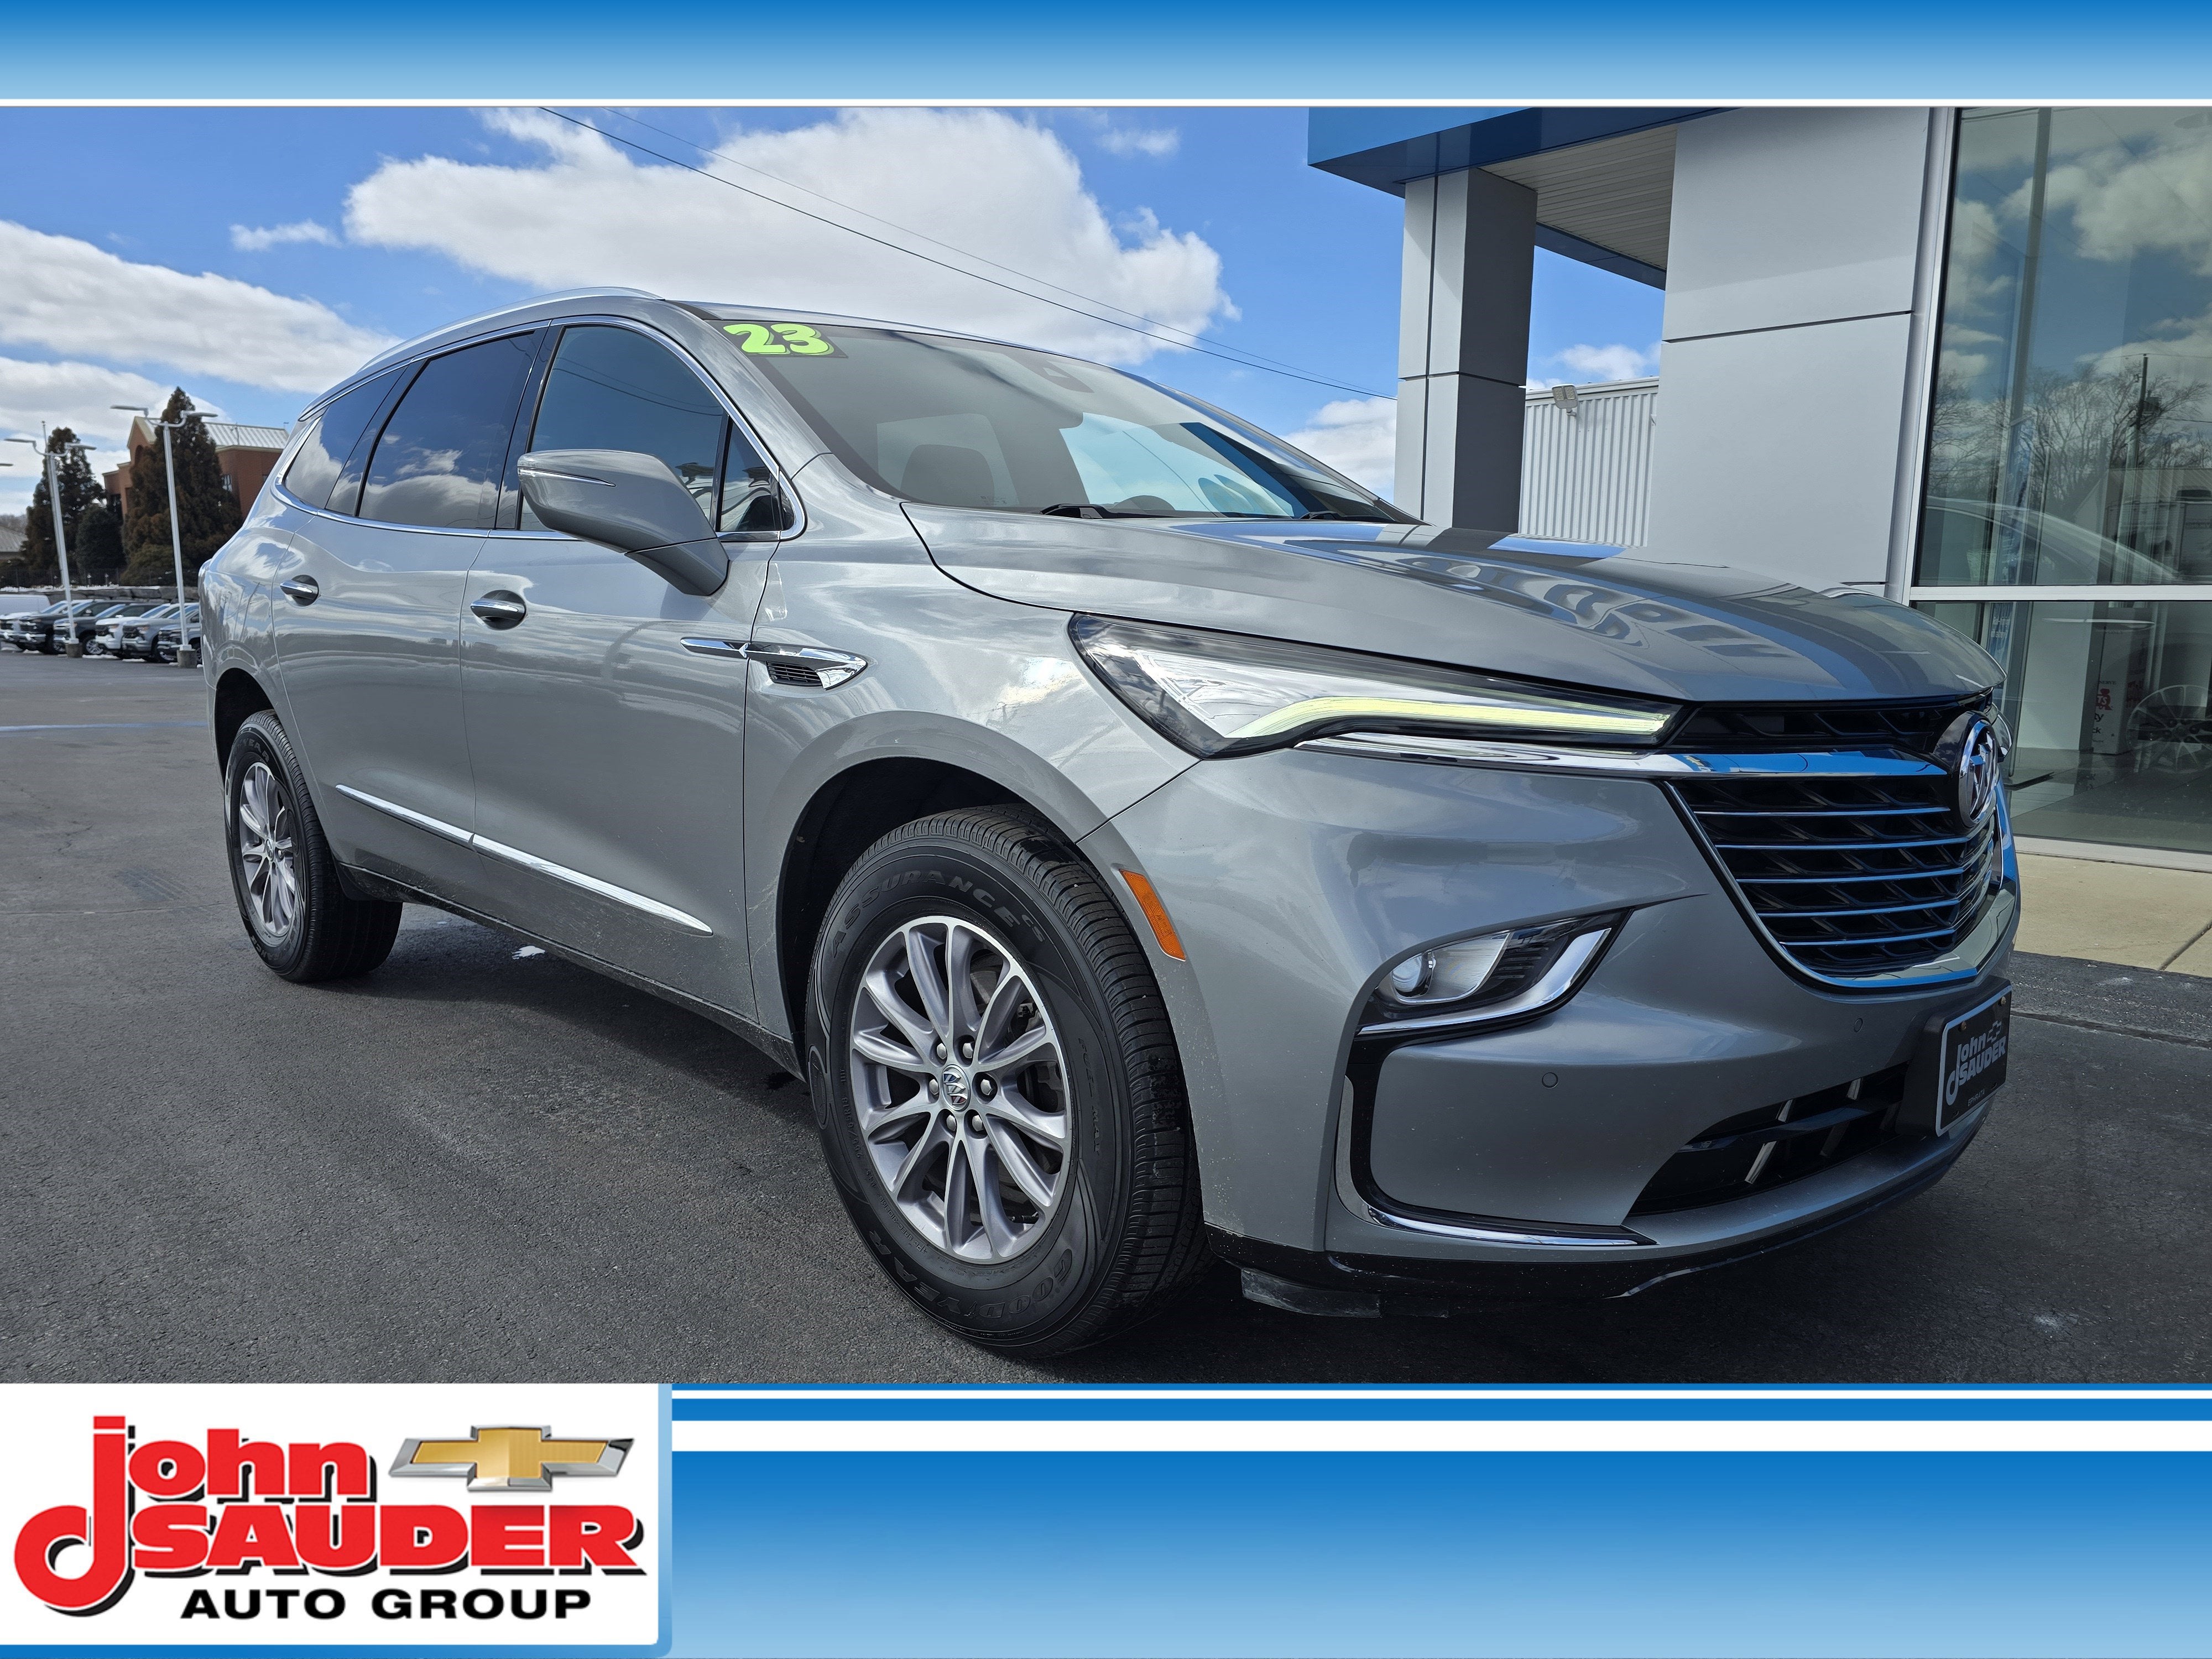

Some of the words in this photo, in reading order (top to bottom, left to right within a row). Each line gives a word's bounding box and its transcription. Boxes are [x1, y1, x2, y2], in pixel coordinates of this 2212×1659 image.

[723, 324, 834, 356] 23
[831, 870, 1020, 958] ASSURANCE
[1021, 914, 1045, 942] CS
[1959, 1036, 2006, 1086] SAUDER
[869, 1230, 1072, 1319] GOODYEAR
